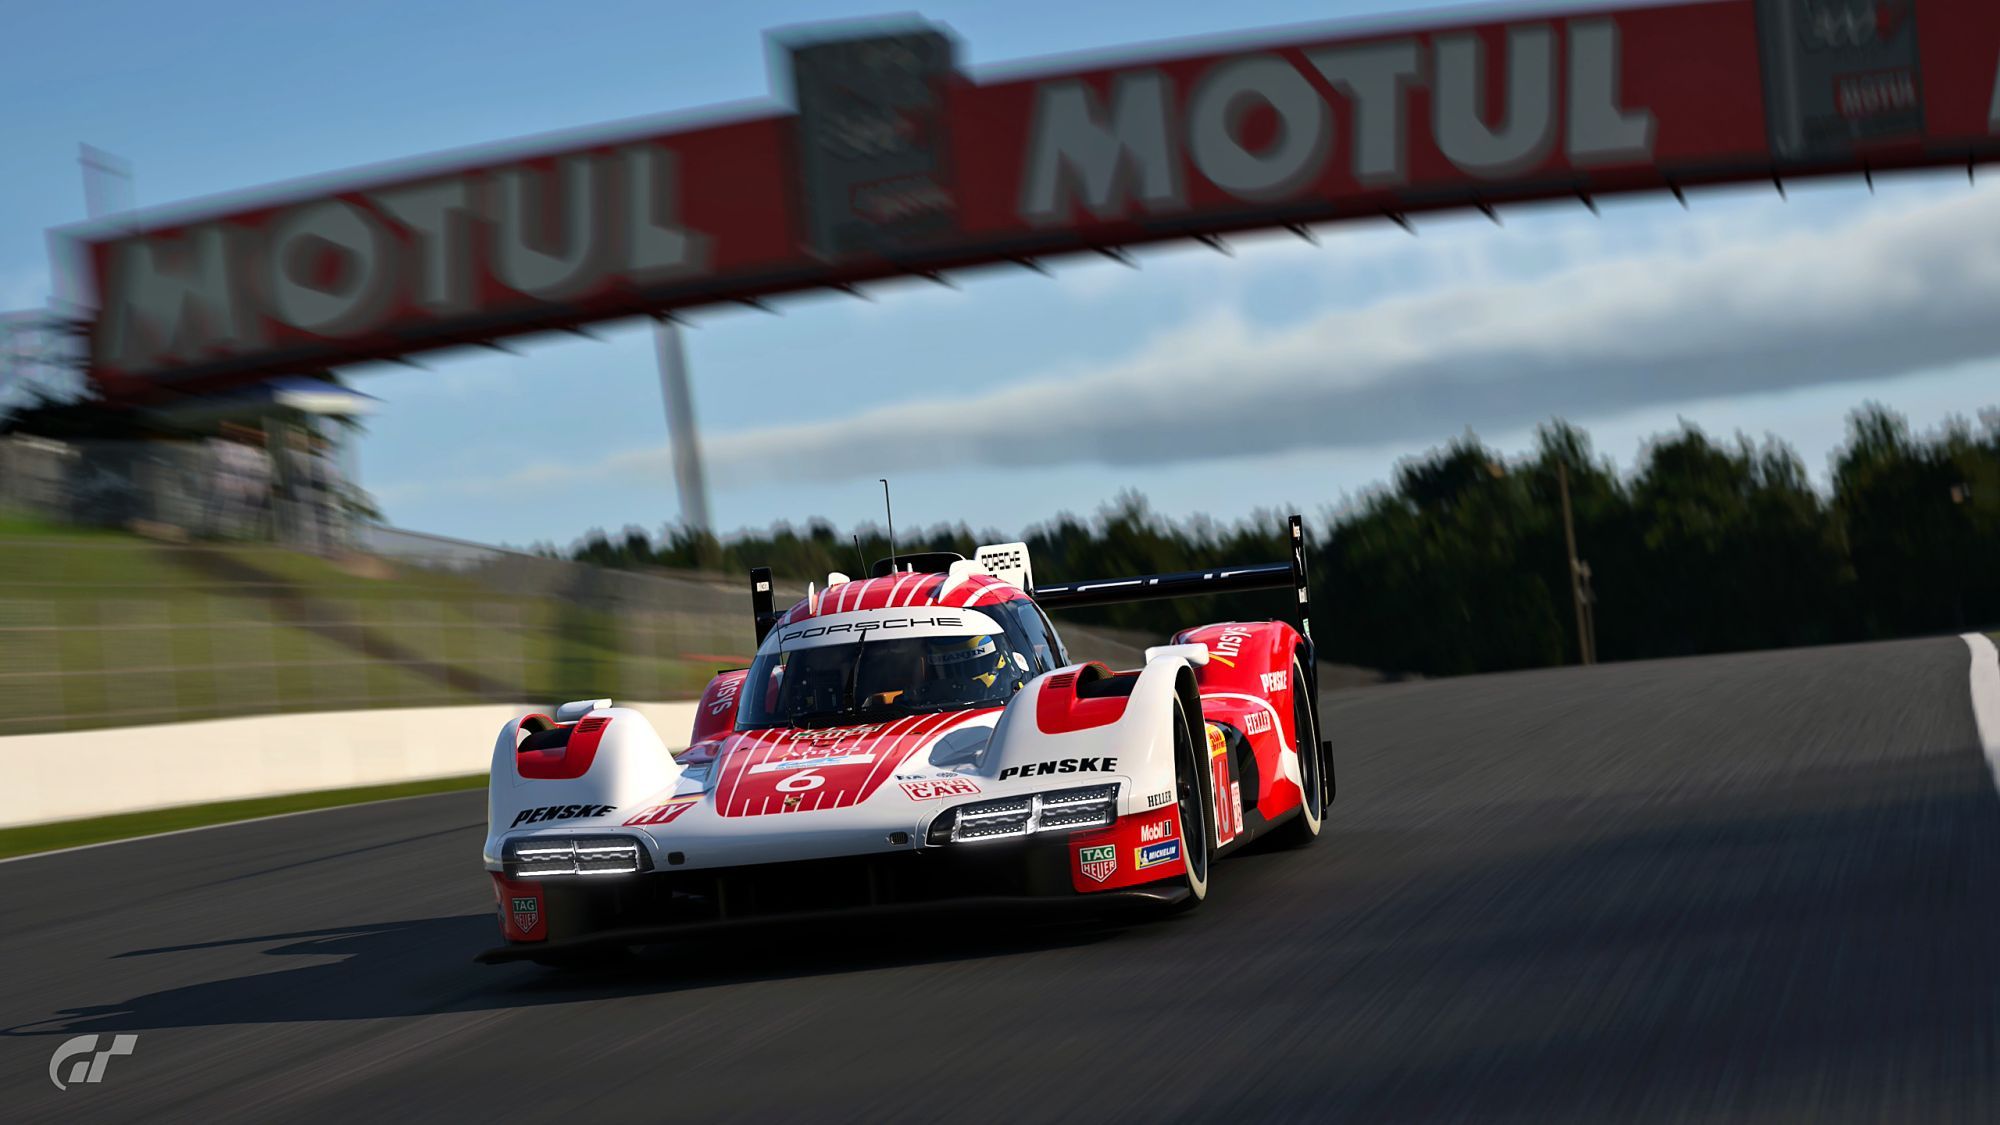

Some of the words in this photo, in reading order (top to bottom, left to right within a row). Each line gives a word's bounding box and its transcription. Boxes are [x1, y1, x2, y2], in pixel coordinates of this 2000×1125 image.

[1020, 17, 1655, 220] MOTUL
[110, 146, 706, 371] MOTUL
[981, 551, 1021, 572] PORSCHE
[781, 617, 963, 644] PORSCHE
[1260, 670, 1287, 693] PENSKE
[998, 757, 1118, 781] PENSKE
[774, 768, 826, 792] 6
[911, 785, 974, 798] CAR
[1147, 790, 1172, 807] HELLER
[510, 805, 617, 828] PENSKE
[1140, 821, 1164, 843] Mobil
[1083, 848, 1114, 861] TAG
[1148, 846, 1176, 860] MICHELIN
[1083, 861, 1115, 878] HEUER
[514, 900, 535, 911] TAG
[514, 913, 537, 930] HEUER
